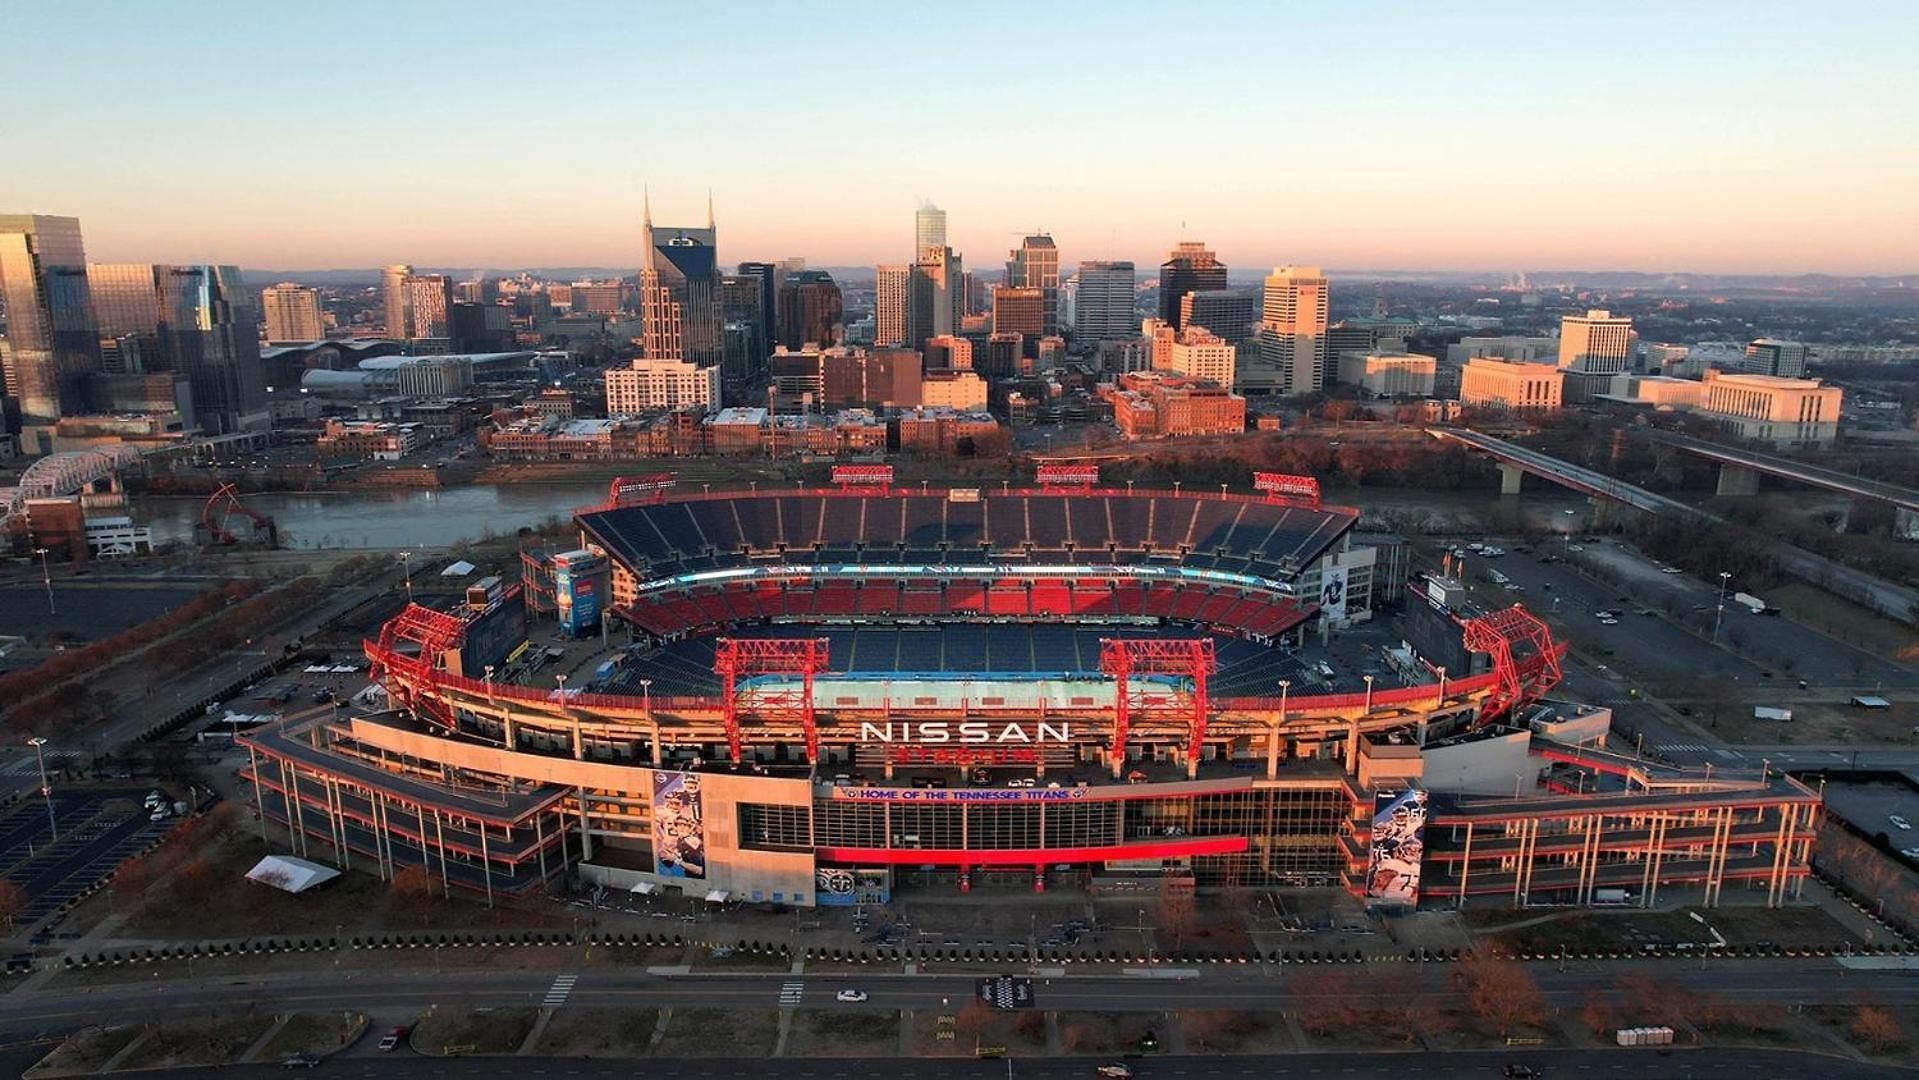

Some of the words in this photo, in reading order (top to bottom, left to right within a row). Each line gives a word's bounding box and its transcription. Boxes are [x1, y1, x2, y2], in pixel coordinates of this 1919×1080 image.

[861, 722, 1069, 742] NISSAN
[860, 790, 897, 799] HOME
[902, 791, 920, 799] OF
[924, 791, 947, 799] THE
[952, 791, 1022, 800] TENNESSEE
[1026, 790, 1068, 799] TITANS
